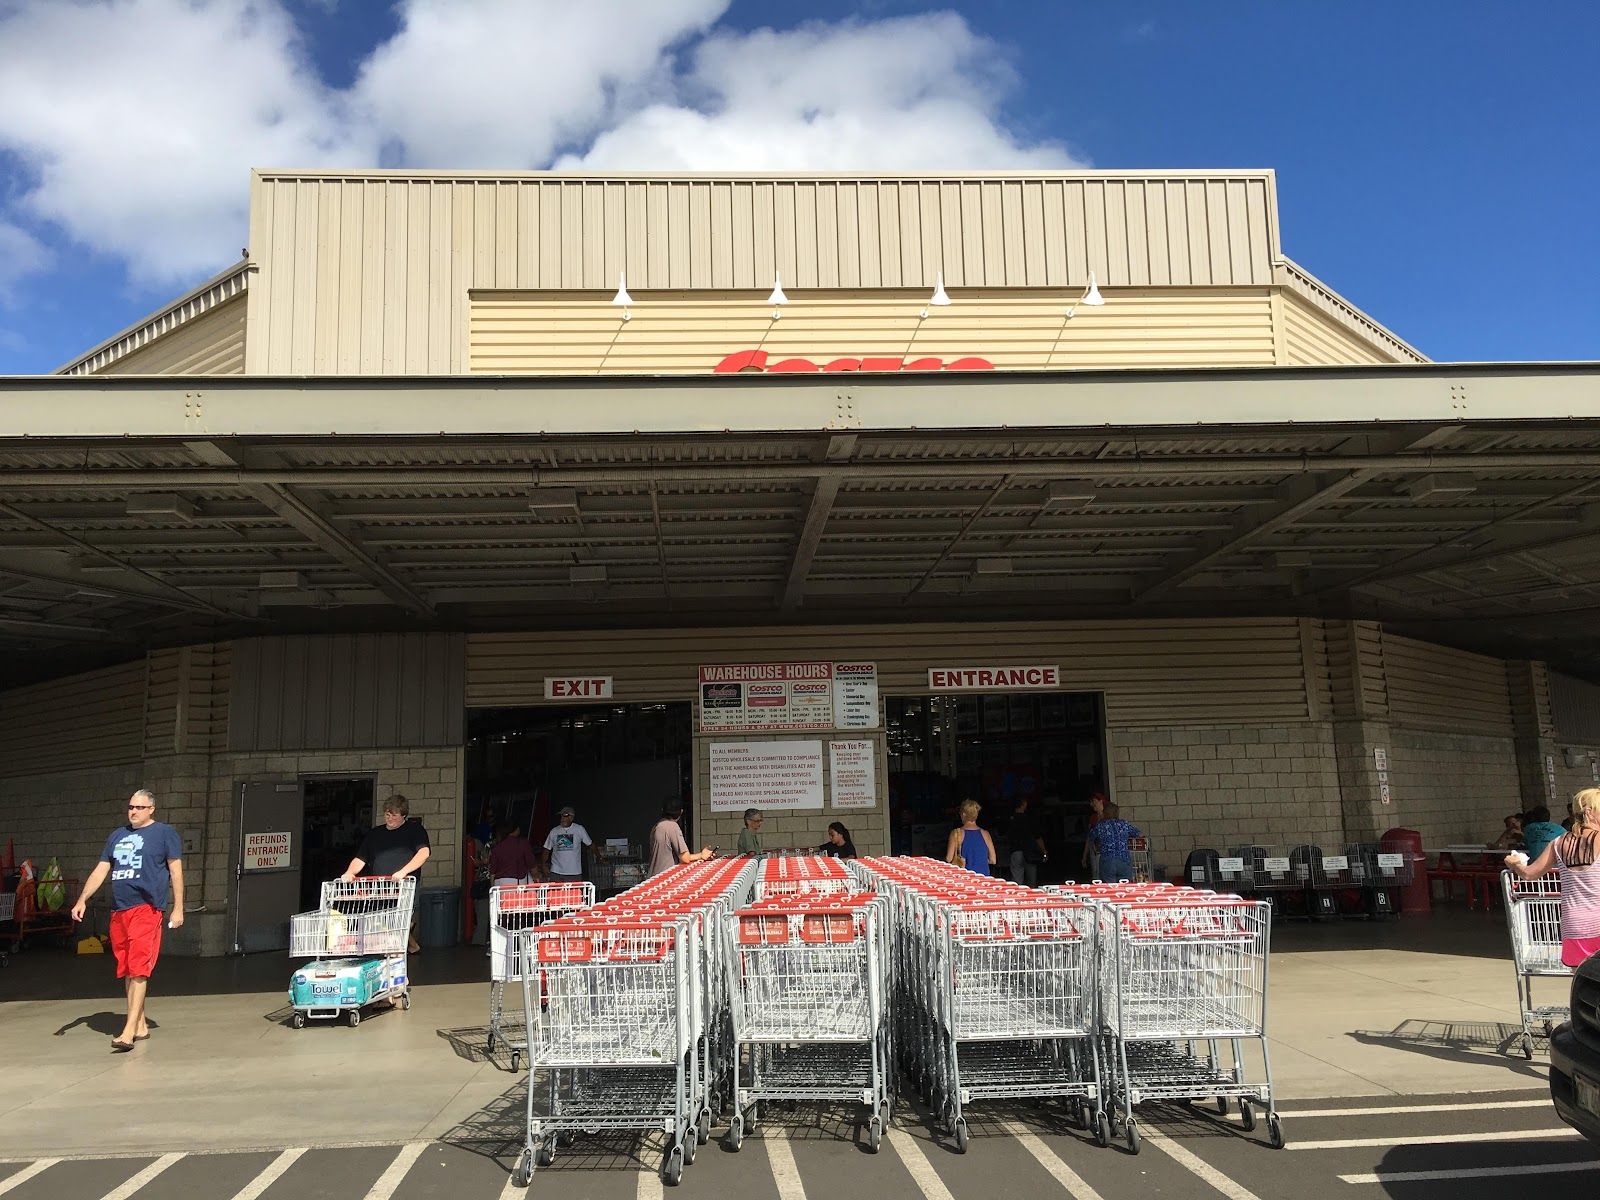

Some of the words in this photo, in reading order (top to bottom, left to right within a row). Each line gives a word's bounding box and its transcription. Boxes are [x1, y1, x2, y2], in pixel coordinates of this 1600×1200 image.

[704, 666, 782, 681] WAREHOUSE
[786, 664, 828, 678] HOURS
[932, 669, 1056, 687] ENTRANCE
[552, 680, 605, 696] EXIT
[249, 835, 287, 845] REFUNDS
[247, 846, 289, 856] ENTRANCE
[257, 857, 278, 866] ONLY
[1379, 893, 1385, 904] 6
[311, 983, 342, 994] Towel
